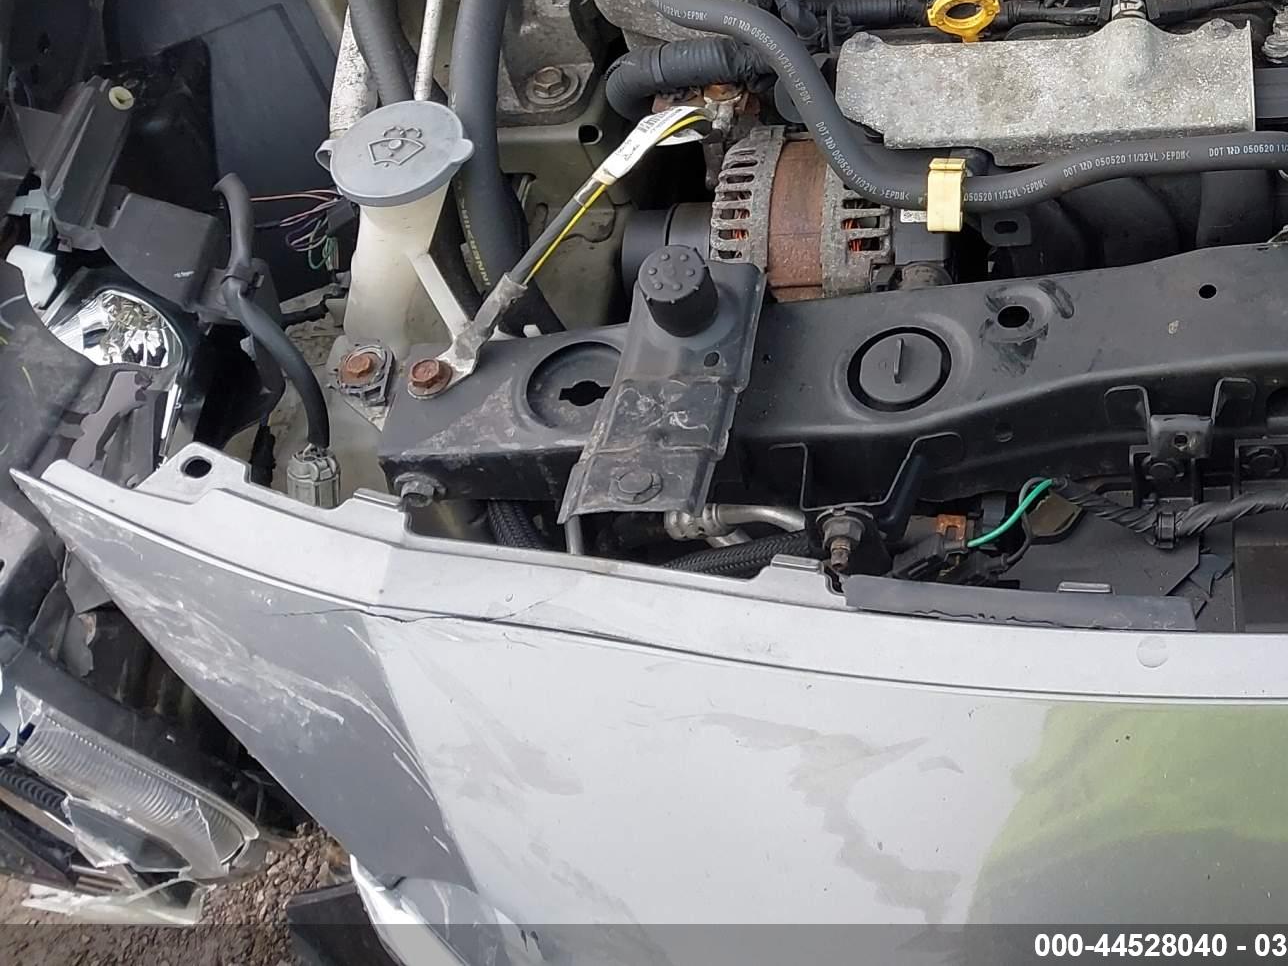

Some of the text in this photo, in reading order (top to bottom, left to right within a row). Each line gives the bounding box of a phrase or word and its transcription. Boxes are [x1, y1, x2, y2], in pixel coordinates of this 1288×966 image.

[723, 15, 738, 27] DOT
[750, 27, 777, 51] 050520
[816, 121, 828, 136] DOT
[1209, 146, 1224, 157] DOT
[1243, 144, 1275, 154] 050520
[1063, 164, 1078, 178] DOT
[1095, 154, 1126, 167] 050520
